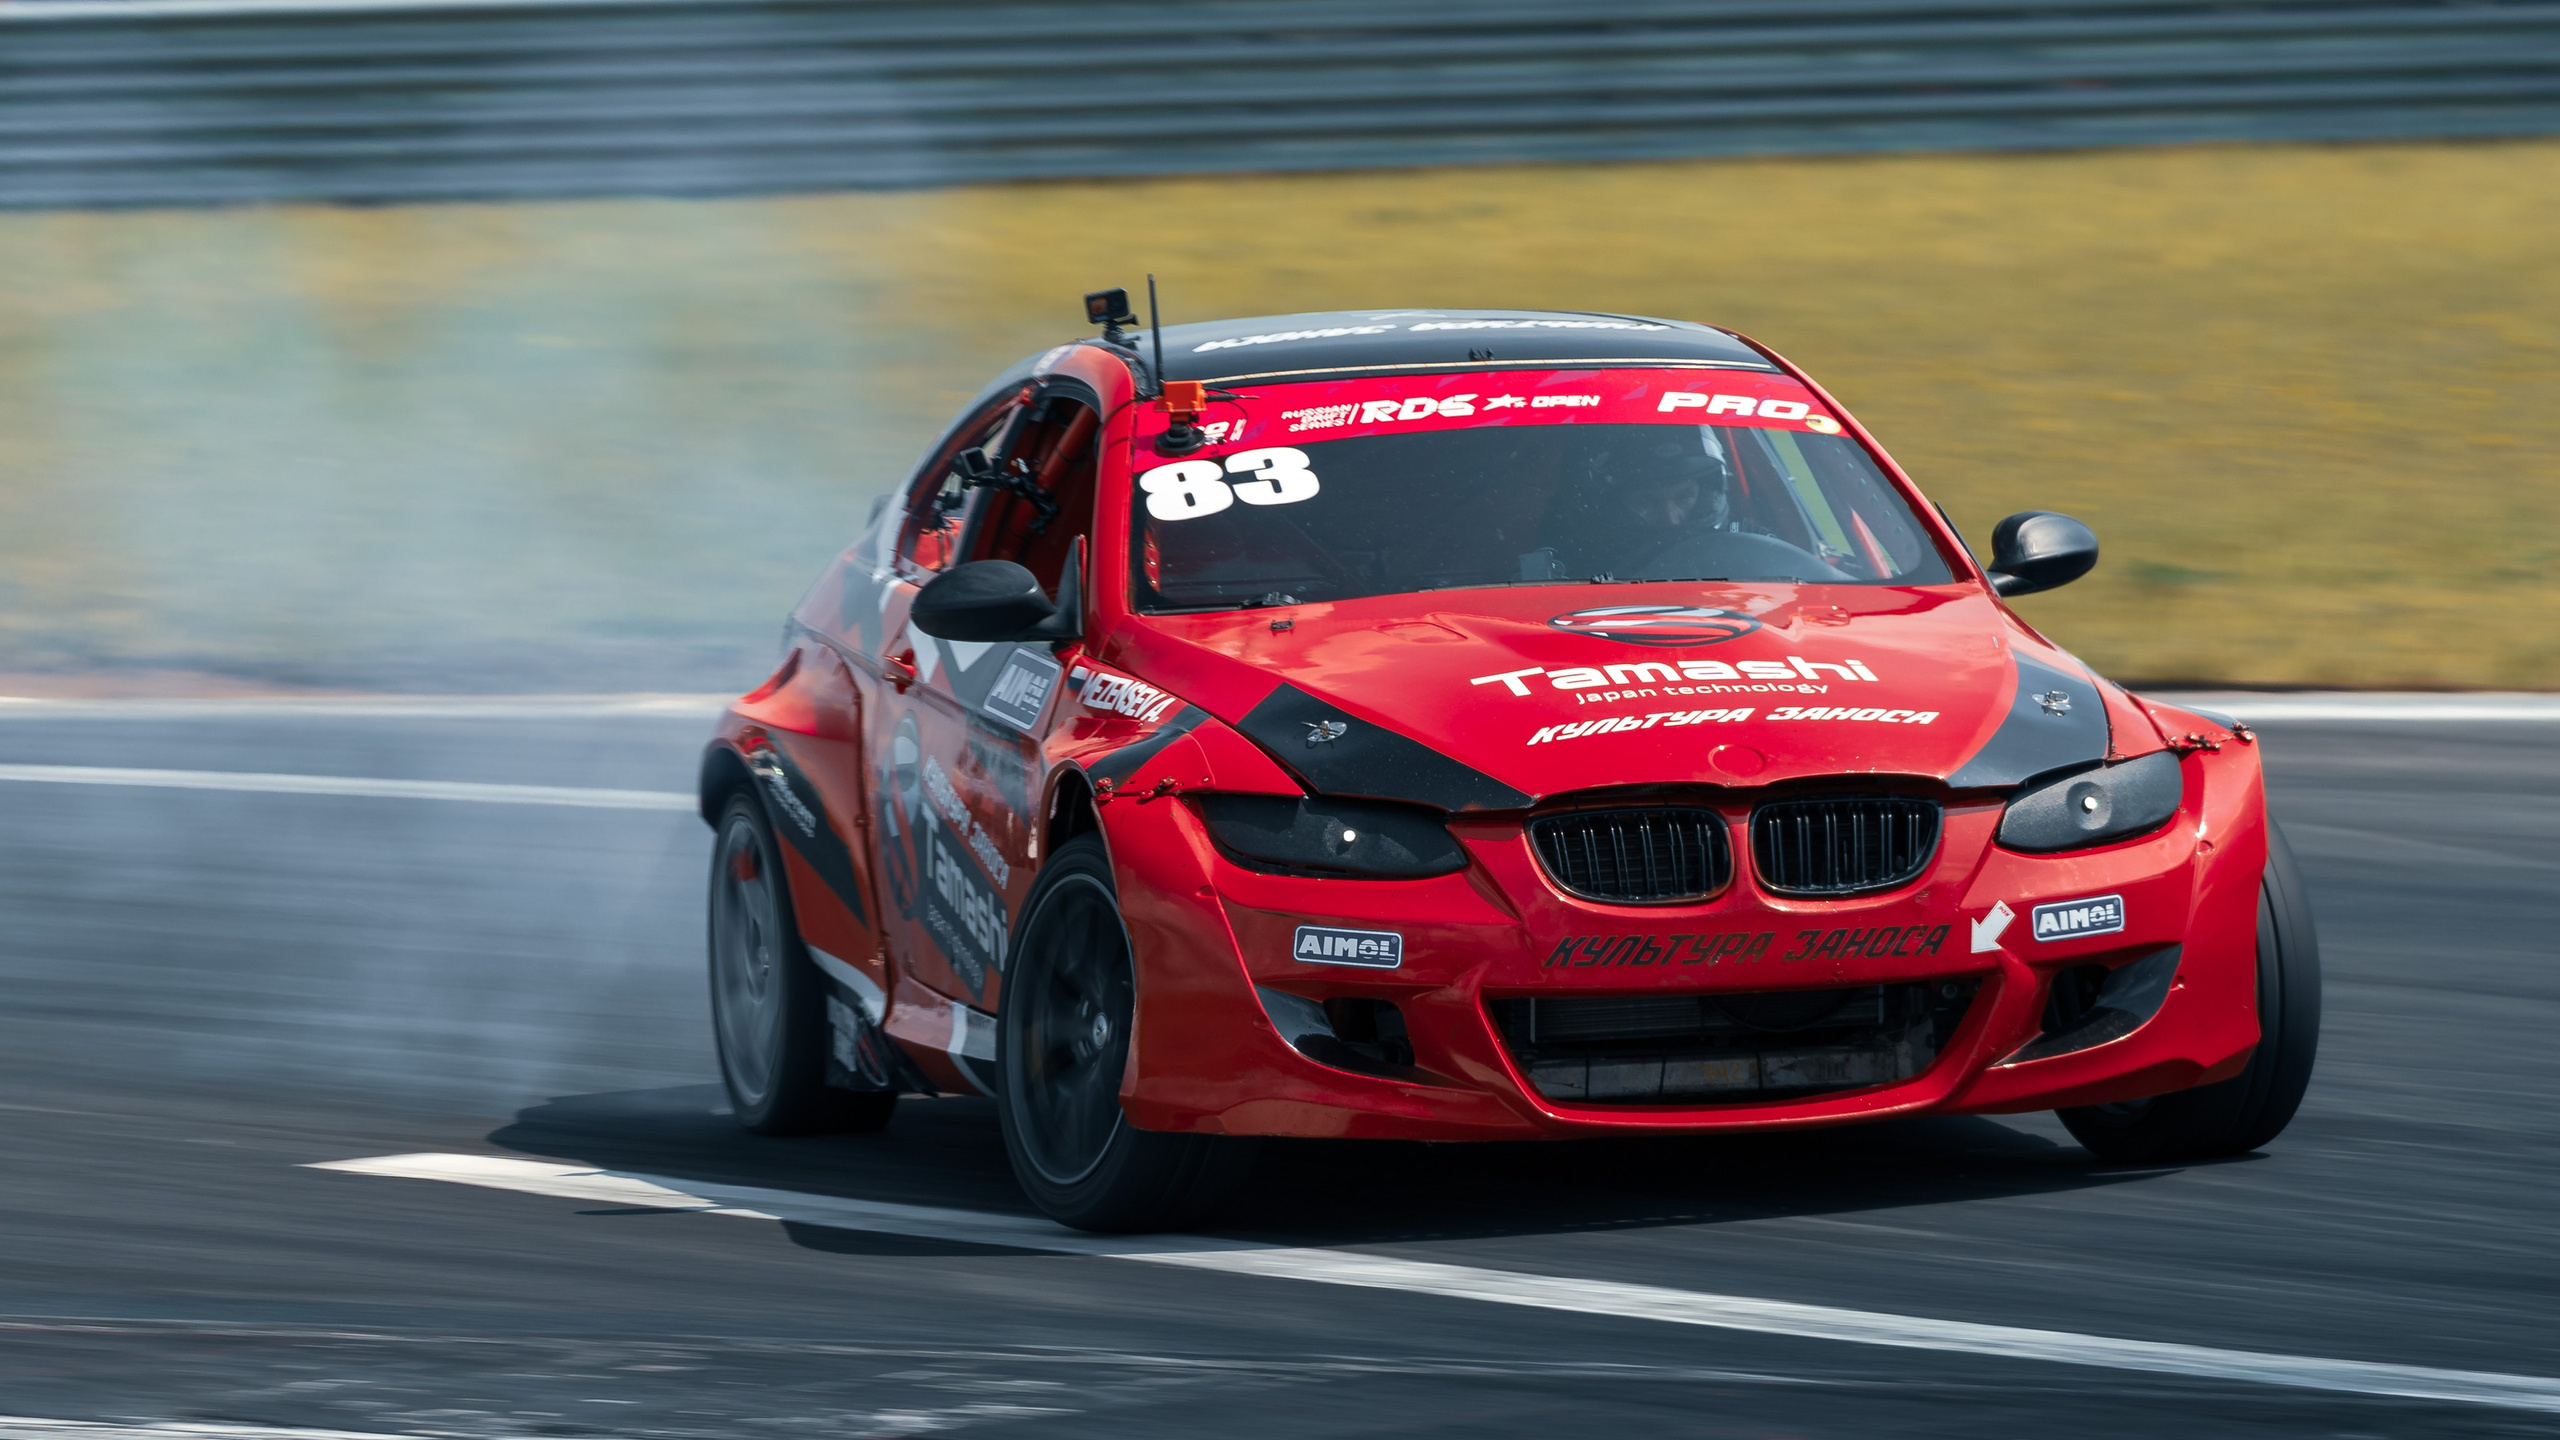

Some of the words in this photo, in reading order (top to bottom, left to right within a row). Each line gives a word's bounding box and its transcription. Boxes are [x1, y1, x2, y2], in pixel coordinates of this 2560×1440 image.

[1281, 403, 1352, 420] RUSSIAN
[1359, 393, 1479, 424] RDS
[1530, 395, 1600, 408] OPEN
[1656, 391, 1810, 420] PRO
[1288, 418, 1345, 433] SERIES
[1139, 446, 1321, 521] 83
[1469, 656, 1879, 698] Tamashi
[1662, 678, 1829, 695] technology
[1526, 707, 1755, 746] КУЛЬТУРА
[1765, 706, 1940, 725] ЗАНОСА
[921, 801, 1010, 972] Tamashi
[2037, 904, 2120, 934] AIMOL
[1298, 934, 1396, 961] AIMOL
[1543, 931, 1776, 968] КУЛЬТУРА
[1783, 924, 1953, 962] ЗАНОСА
